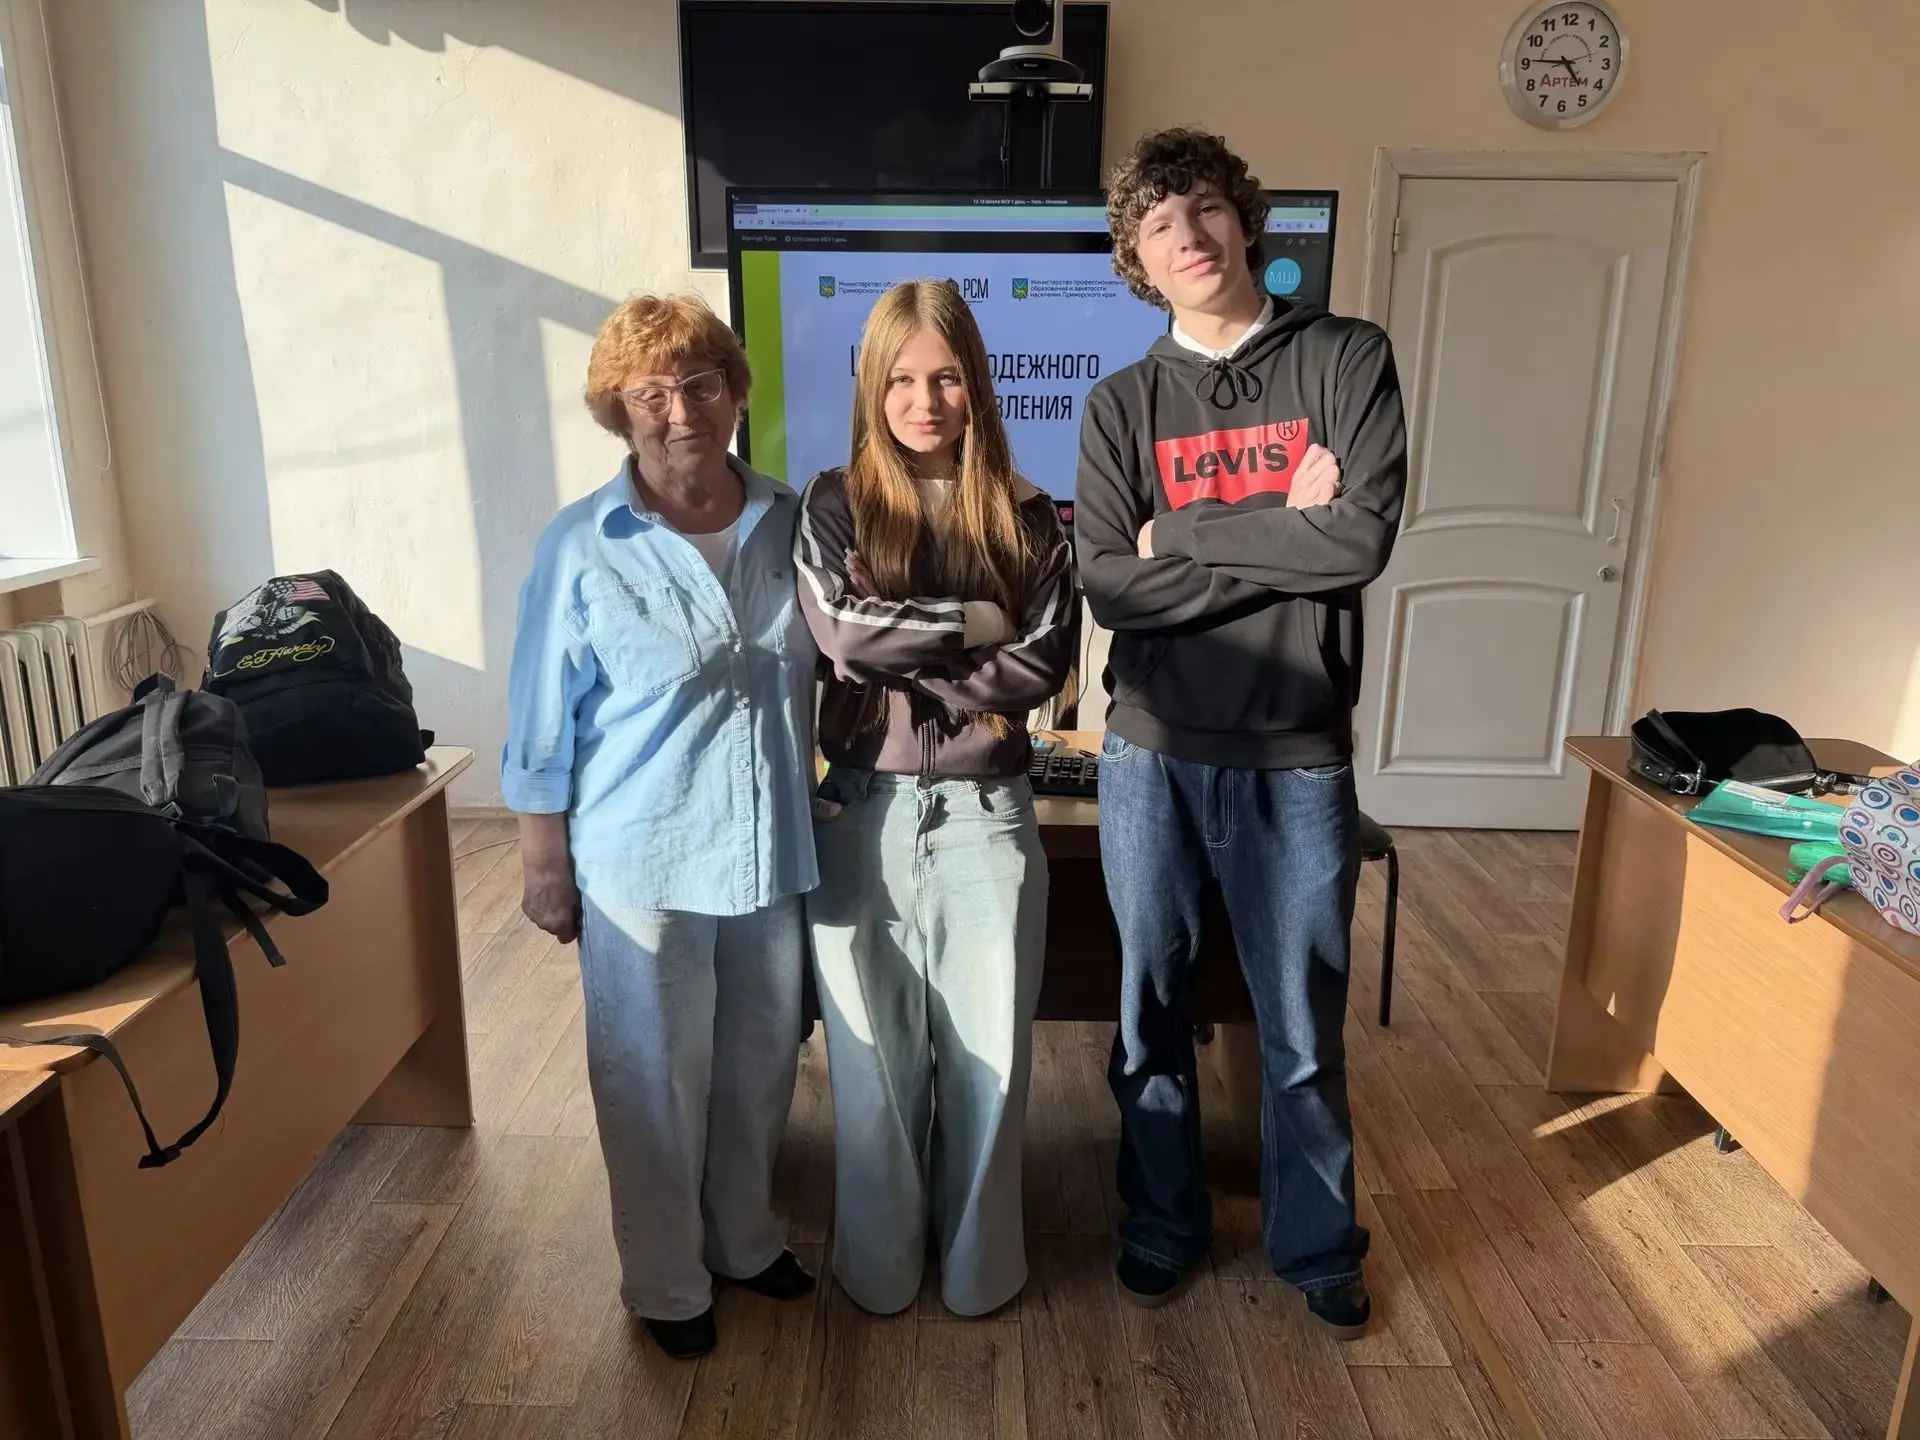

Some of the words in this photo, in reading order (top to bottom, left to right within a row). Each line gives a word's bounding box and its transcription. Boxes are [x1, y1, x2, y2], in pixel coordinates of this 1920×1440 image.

[1541, 19, 1556, 31] 11
[1561, 13, 1579, 26] 12
[1588, 19, 1595, 31] 1
[1527, 35, 1543, 47] 10
[1599, 35, 1609, 48] 2
[1521, 58, 1531, 70] 9
[1601, 58, 1611, 71] 3
[1526, 79, 1535, 91] 8
[1593, 79, 1603, 91] 4
[1539, 95, 1548, 107] 7
[1557, 100, 1566, 112] 6
[1577, 95, 1587, 107] 5
[1269, 271, 1297, 284] МШ
[839, 280, 882, 288] Министерство
[963, 278, 989, 299] РСМ
[839, 287, 880, 295] Приморского
[987, 354, 1100, 384] ОДЕЖНОГО
[996, 395, 1072, 420] ВЛЕНИЯ
[236, 650, 271, 669] Ed
[263, 638, 331, 664] Hardy
